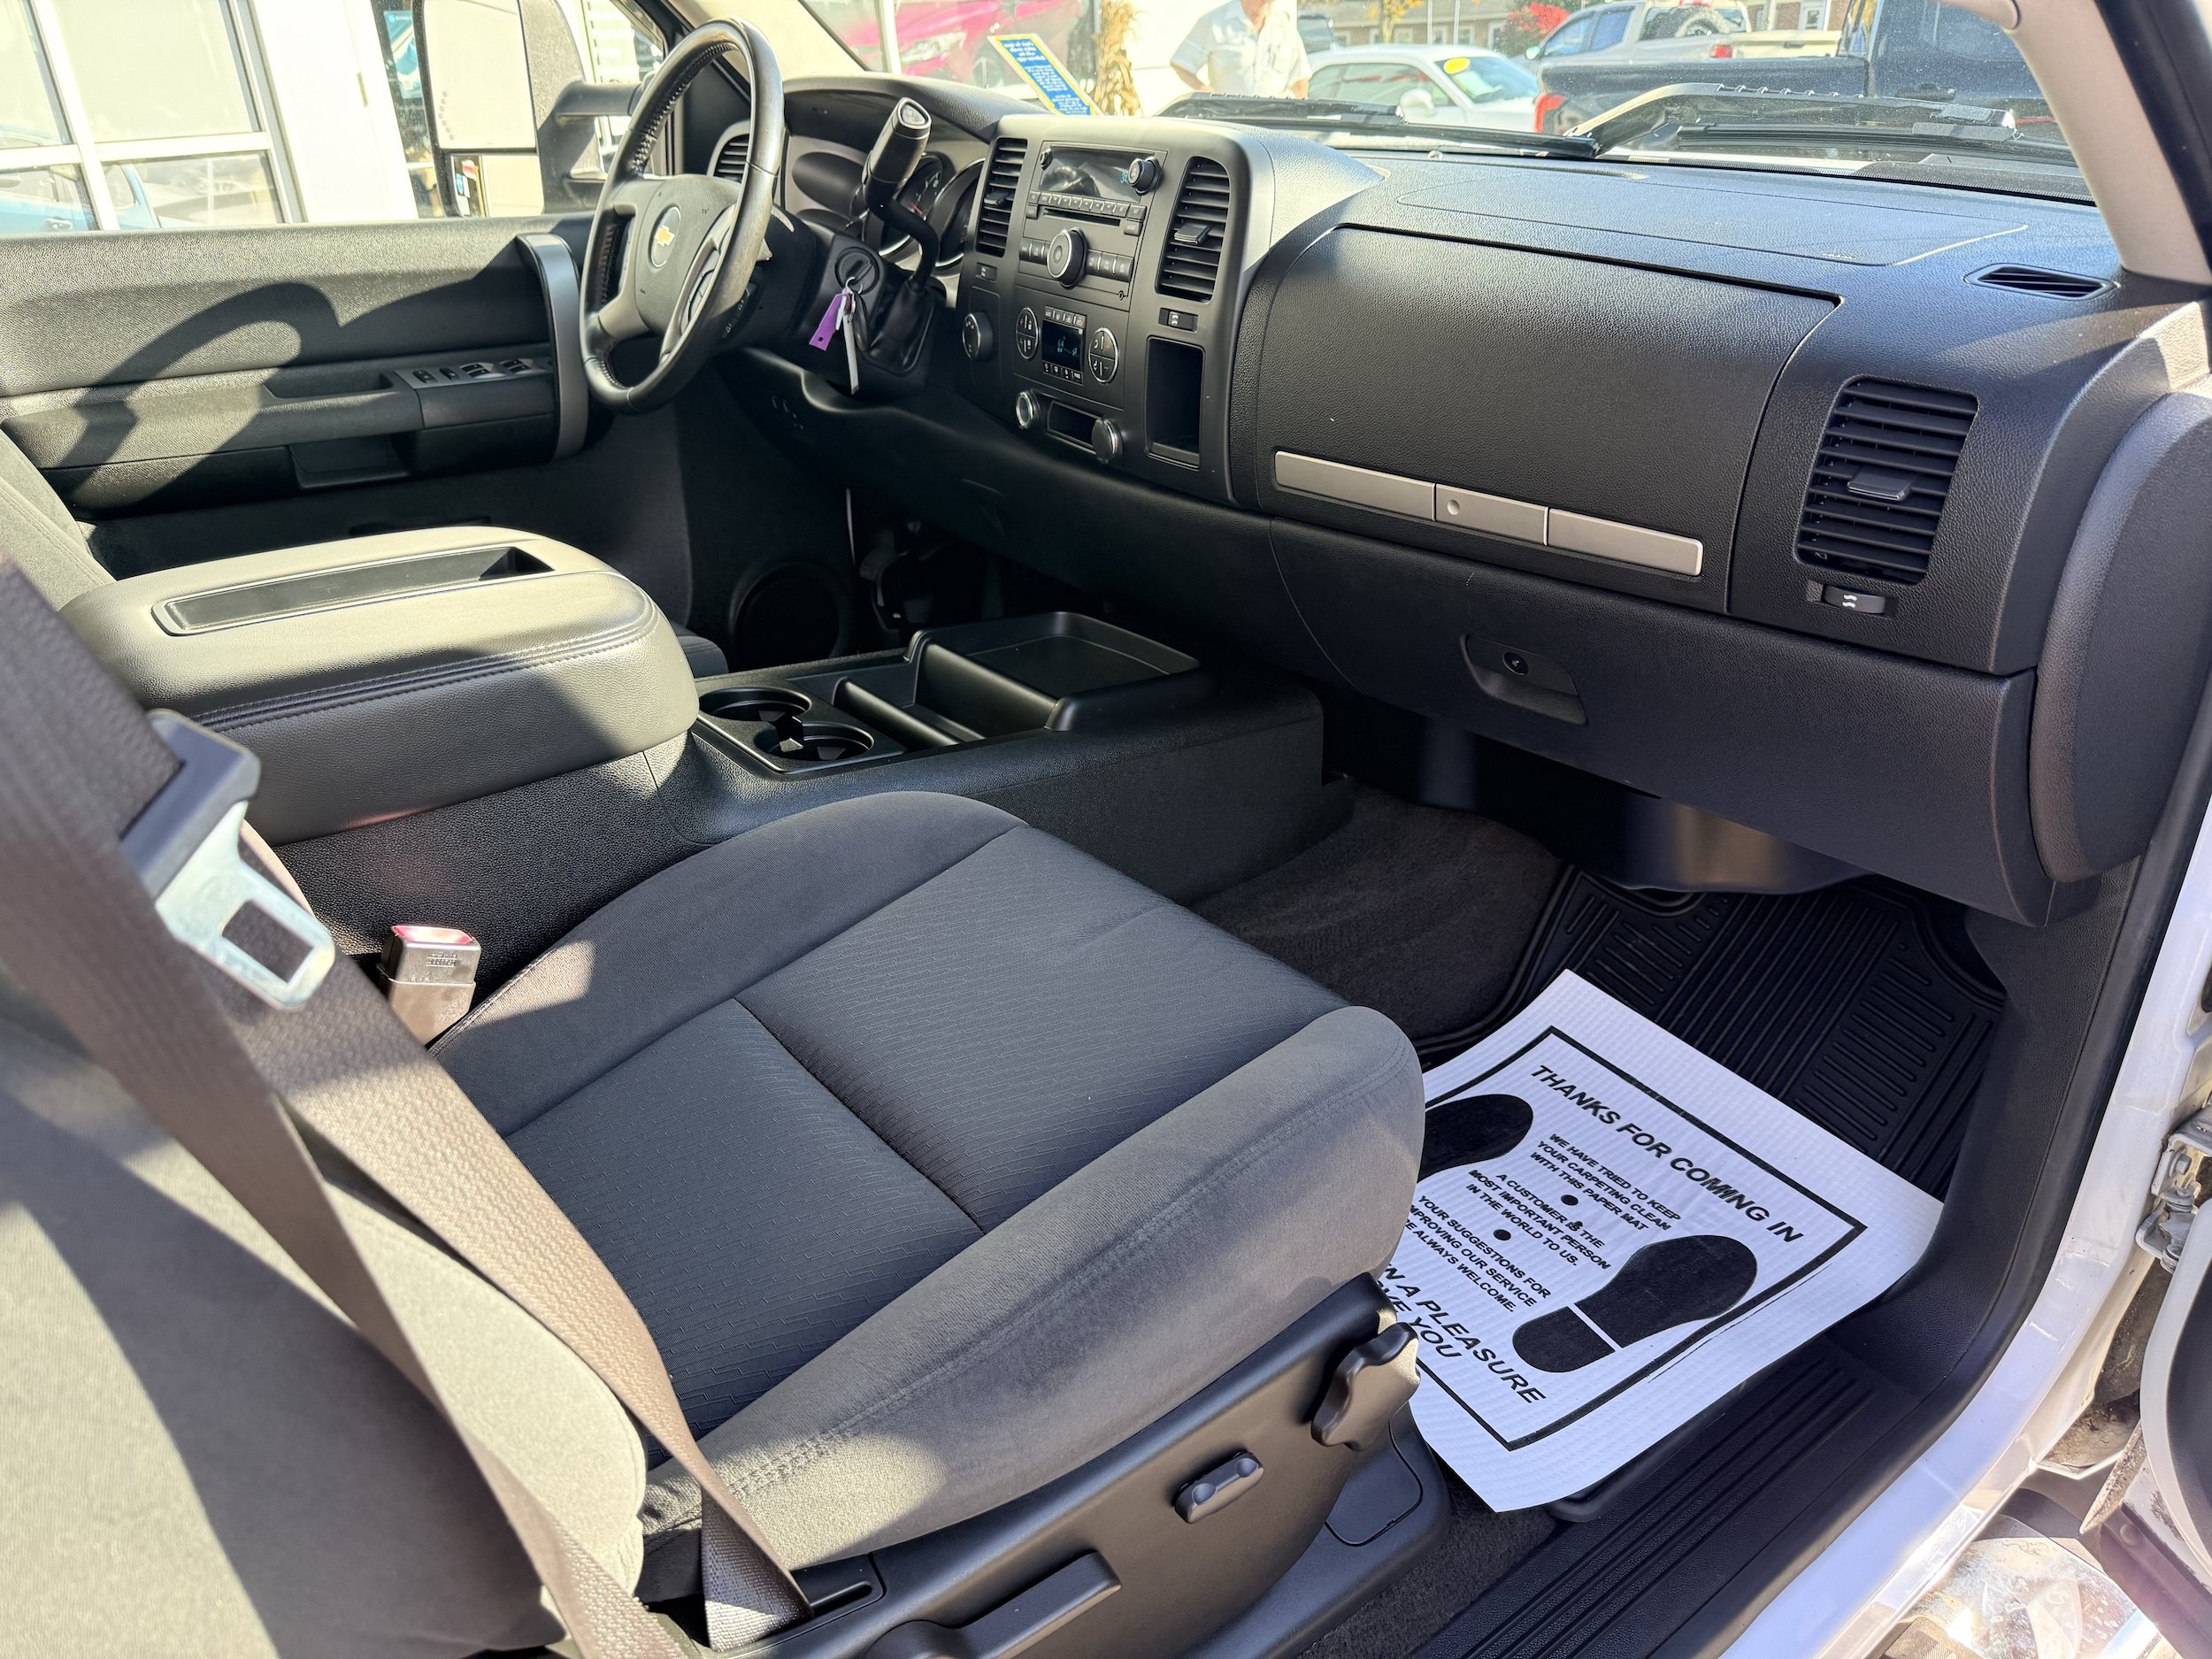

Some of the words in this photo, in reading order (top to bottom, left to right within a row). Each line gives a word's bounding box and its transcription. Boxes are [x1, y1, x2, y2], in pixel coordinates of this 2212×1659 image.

[1530, 1151, 1560, 1172] WITH
[1558, 1170, 1585, 1189] THIS
[1583, 1187, 1623, 1215] PAPER
[1620, 1213, 1649, 1231] MAT
[1531, 1064, 1621, 1125] THANKS
[1615, 1123, 1672, 1158] FOR
[1670, 1157, 1770, 1222] COMING
[1766, 1221, 1804, 1242] IN
[1537, 1141, 1569, 1164] YOUR
[1567, 1162, 1632, 1205] CARPETING
[1630, 1203, 1672, 1231] CLEAN
[1548, 1133, 1570, 1148] WE
[1566, 1146, 1599, 1168] HAVE
[1597, 1164, 1632, 1189] TRIED
[1631, 1187, 1648, 1201] TO
[1647, 1199, 1681, 1220] KEEP
[1409, 1204, 1463, 1248] MPROVING
[1461, 1248, 1488, 1269] OUR
[1486, 1268, 1538, 1307] SERVICE
[1418, 1195, 1450, 1221] YOUR
[1447, 1219, 1526, 1279] SUGGESTIONS
[1523, 1277, 1551, 1299] FOR
[1465, 1184, 1481, 1194] IN
[1479, 1192, 1503, 1211] THE
[1501, 1209, 1543, 1239] WORLD
[1542, 1237, 1560, 1251] TO
[1559, 1249, 1579, 1266] US.
[1468, 1169, 1502, 1192] MOST
[1499, 1190, 1564, 1235] IMPORTANT
[1560, 1234, 1611, 1270] PERSON
[1507, 1180, 1569, 1224] CUSTOMER
[1579, 1230, 1606, 1248] THE
[1413, 1229, 1459, 1265] ALWAYS
[1456, 1263, 1517, 1313] WELCOME.
[1394, 1284, 1422, 1298] A
[1415, 1300, 1547, 1403] PLEASURE
[1409, 1317, 1463, 1357] YOU
